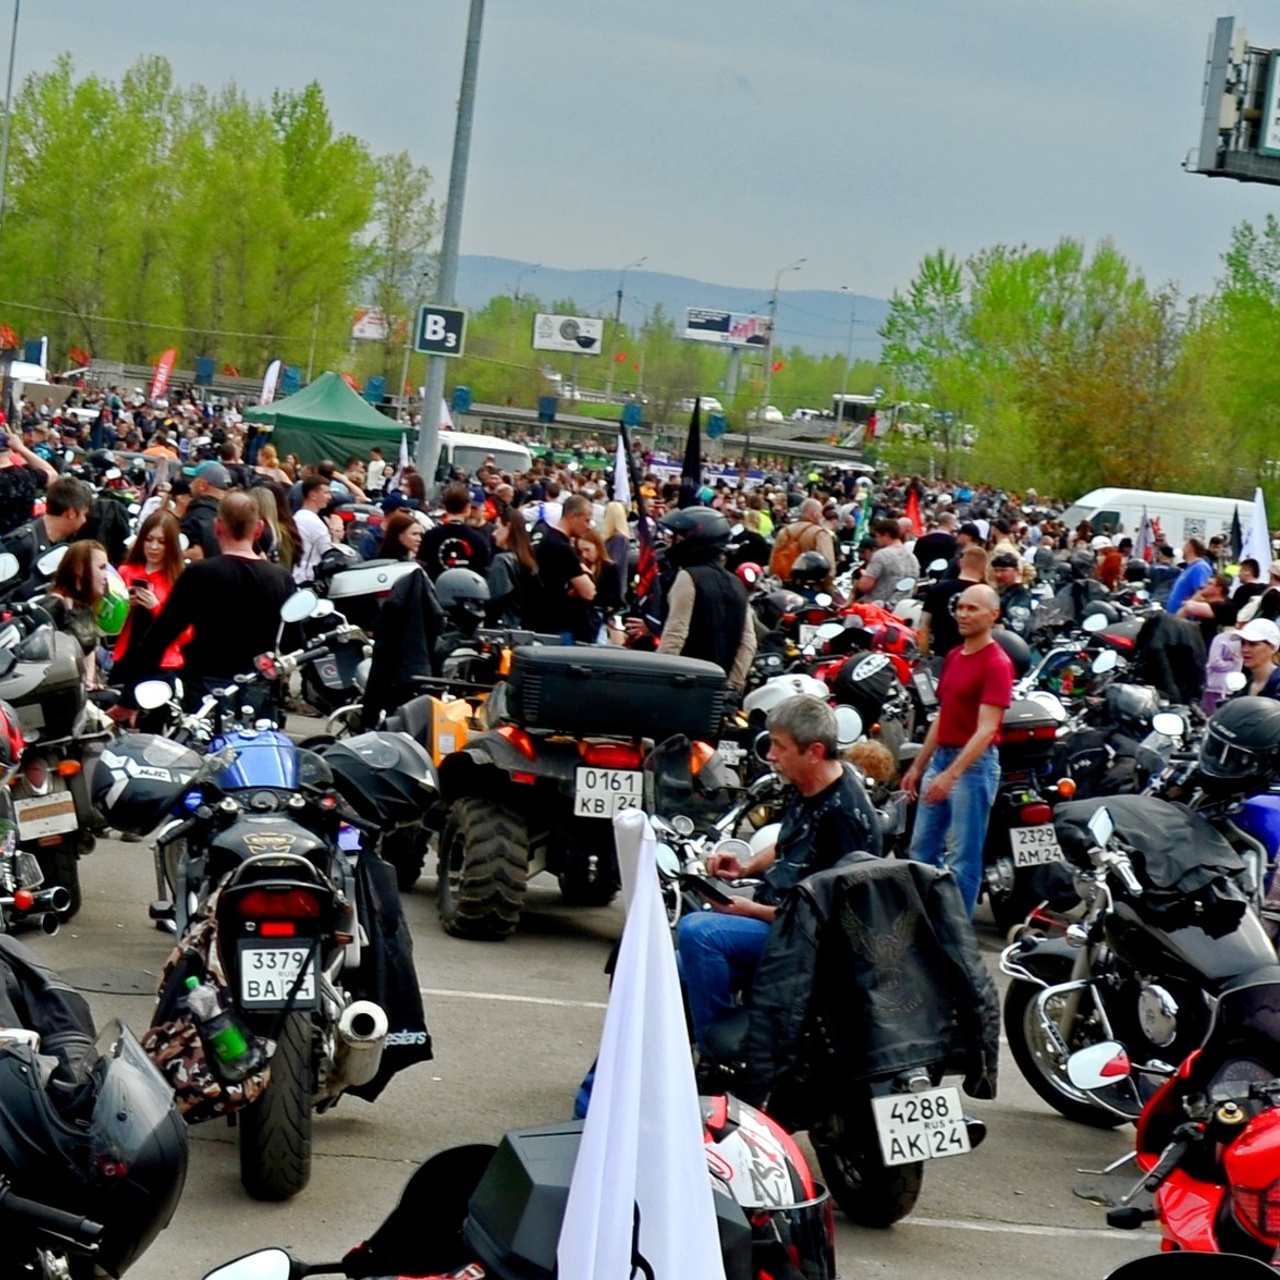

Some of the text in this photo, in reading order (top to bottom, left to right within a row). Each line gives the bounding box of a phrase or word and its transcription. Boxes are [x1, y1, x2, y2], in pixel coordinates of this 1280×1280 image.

[585, 770, 634, 792] 0161
[580, 798, 605, 814] KB
[1018, 828, 1054, 845] 2329
[1018, 847, 1062, 865] AM 24
[252, 951, 304, 970] 3379
[248, 980, 277, 998] BA
[890, 1095, 949, 1124] 4288
[924, 1120, 946, 1130] RUS
[890, 1127, 963, 1160] AK 24
